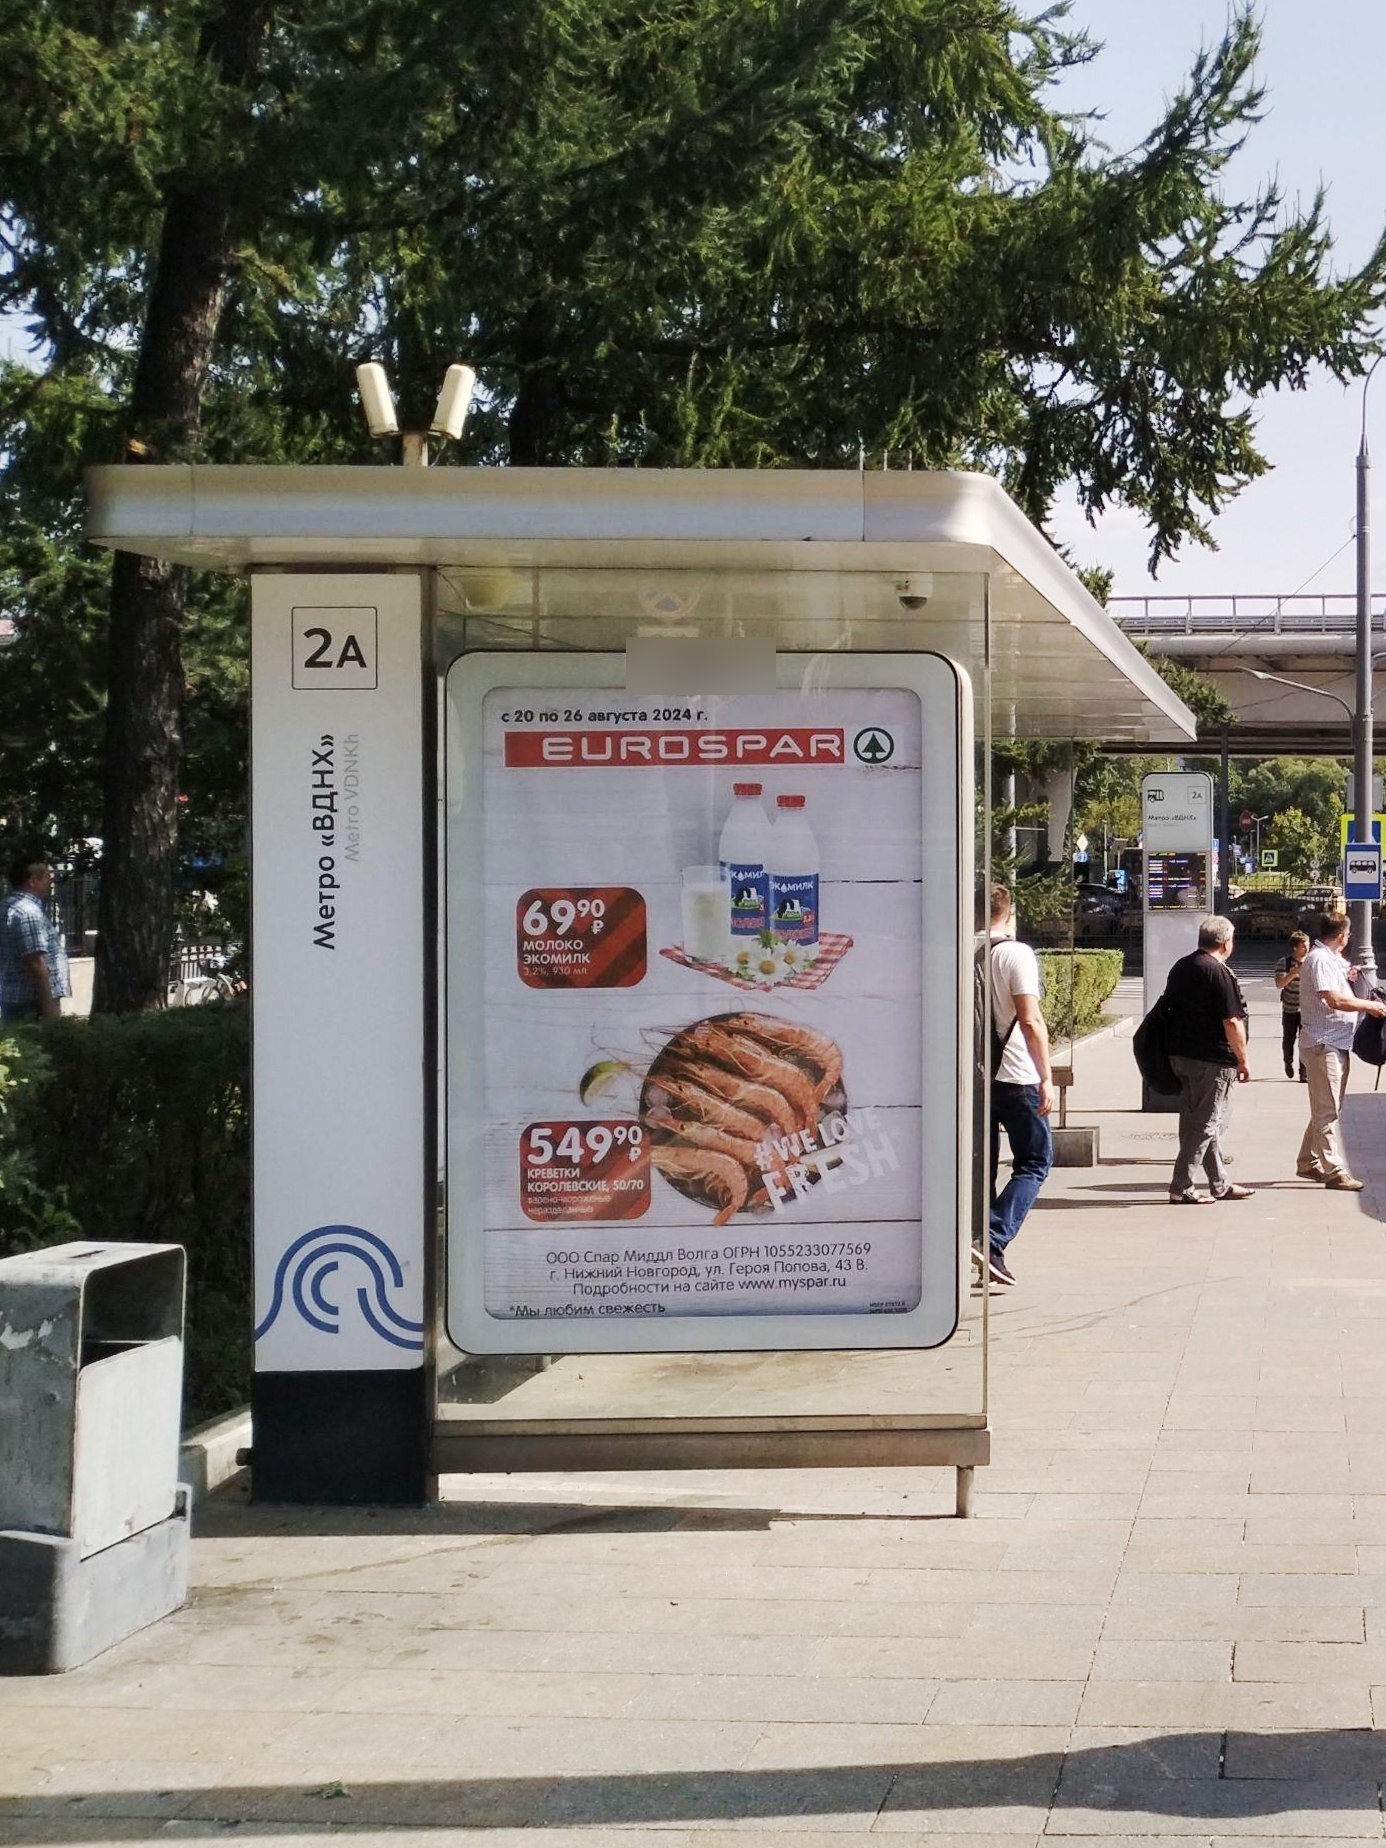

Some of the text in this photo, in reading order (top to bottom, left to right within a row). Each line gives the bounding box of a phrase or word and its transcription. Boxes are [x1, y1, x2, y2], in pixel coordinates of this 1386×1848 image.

[303, 627, 367, 669] 2А
[501, 708, 708, 725] с 20 по 26 августа 2024 г.
[542, 733, 841, 761] EUROSPAR
[344, 733, 360, 863] Metro VDNKh
[312, 733, 340, 950] Метро «ВДНХ»
[523, 940, 583, 951] МОЛОКО
[523, 953, 591, 965] ЭКОМИЛК
[818, 1108, 881, 1147] LOVE
[527, 1167, 580, 1179] КРЕВЕТКИ
[527, 1179, 644, 1193] КОРОЛЕВСКИЕ, 50/70
[546, 1243, 871, 1265] ООО Спар Миддл Волга ОГРН 1055233077569
[549, 1258, 868, 1281] г. Нижний Новгород, ул. Героя Попова, 43 В.
[573, 1275, 846, 1297] Подробности на сайте www.myspar.ru
[544, 1303, 595, 1316] любим
[598, 1302, 666, 1314] свежесть
